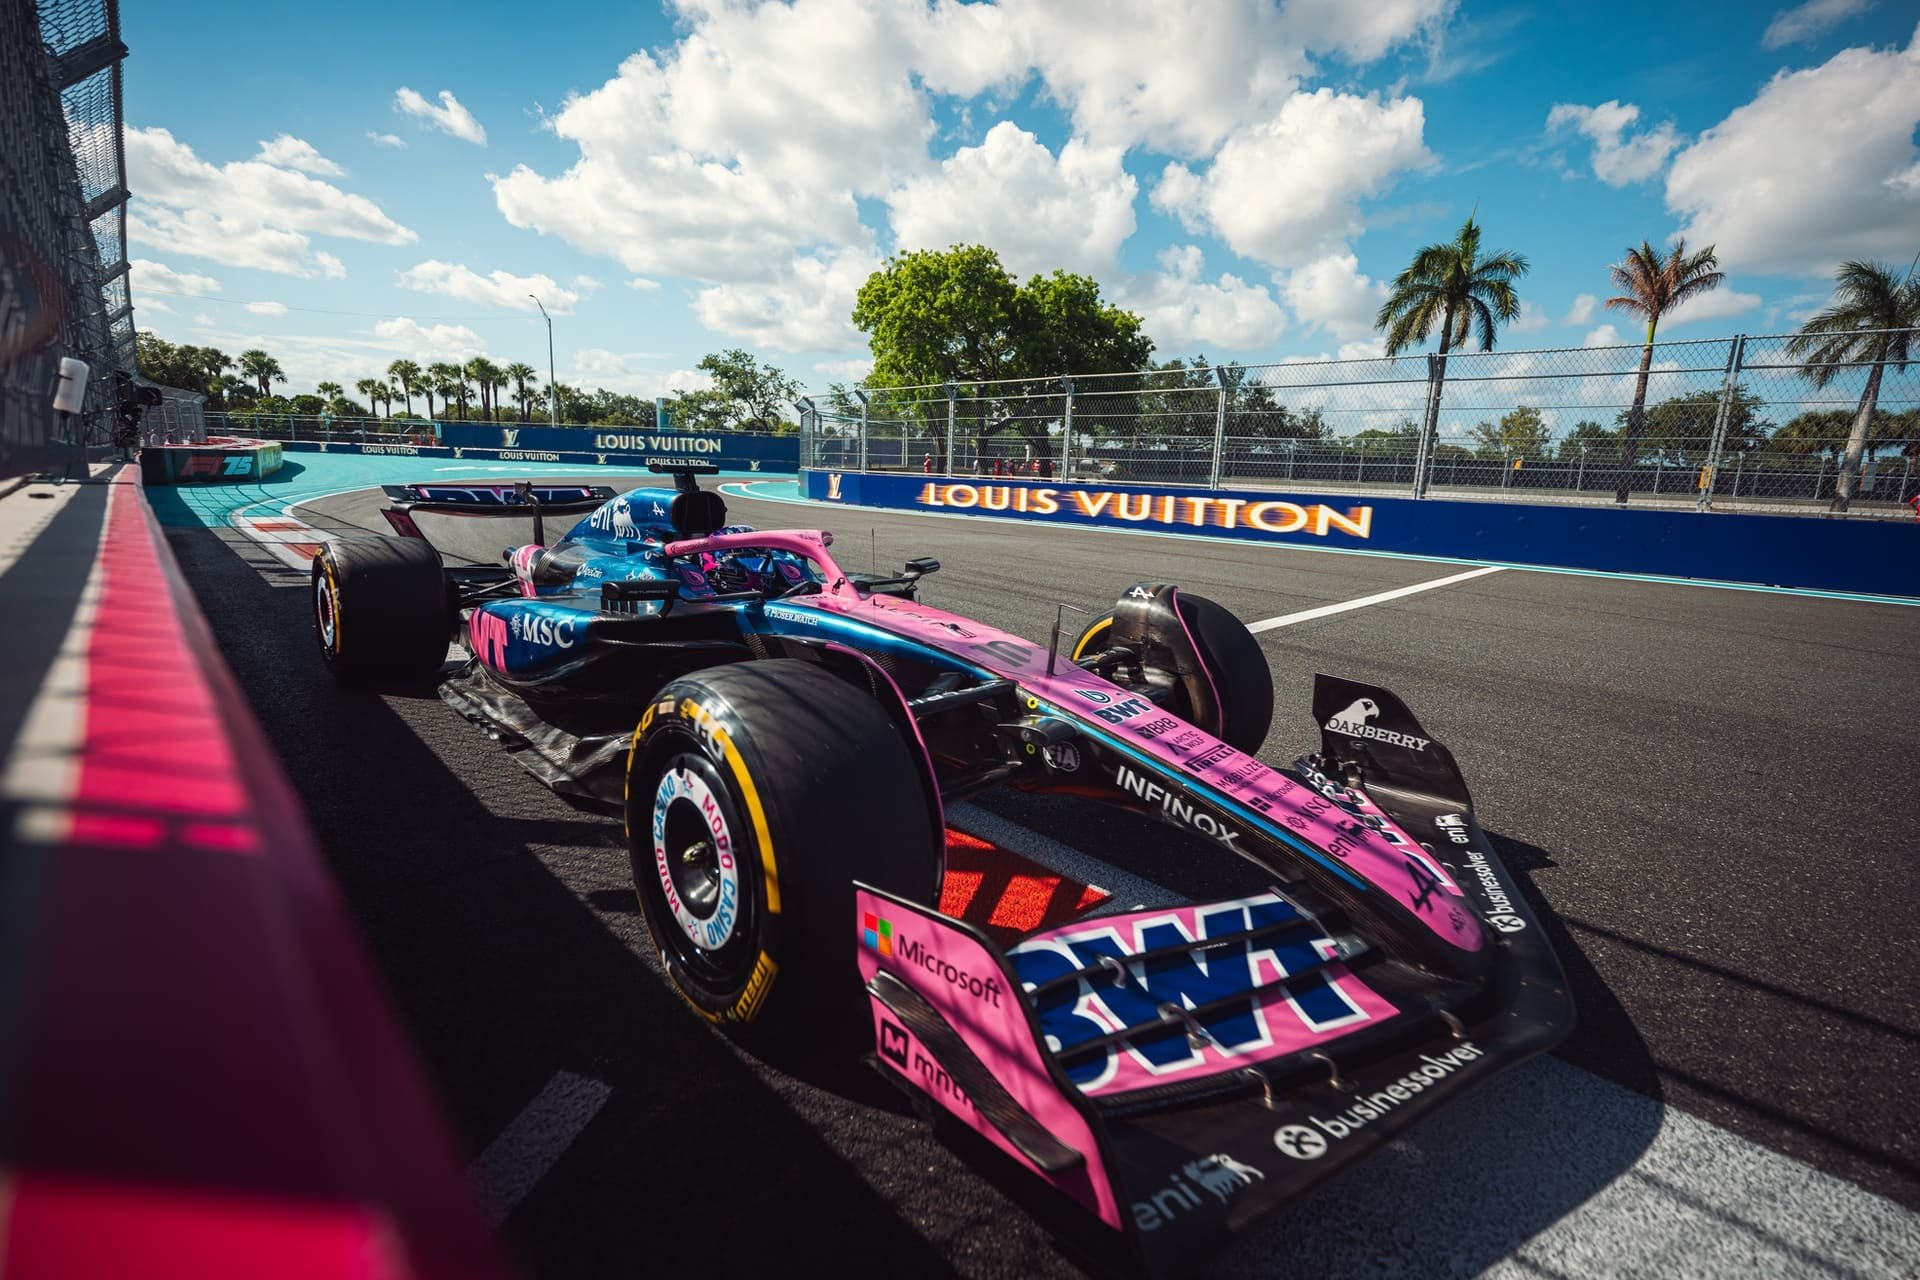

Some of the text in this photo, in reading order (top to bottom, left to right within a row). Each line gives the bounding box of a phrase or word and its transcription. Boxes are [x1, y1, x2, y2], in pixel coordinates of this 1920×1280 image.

[362, 445, 419, 456] LOUIS VUITTON
[499, 451, 560, 462] LOUIS VUITTON
[595, 434, 722, 453] LOUIS VUITTON
[646, 457, 671, 465] LOUIS
[223, 456, 254, 476] 75
[590, 506, 611, 531] eni
[925, 482, 1373, 540] LOUIS VUITTON
[523, 613, 575, 649] MSC
[1091, 697, 1152, 725] BWT
[1146, 717, 1179, 736] BRB
[1325, 717, 1431, 752] OAKBERRY
[1183, 743, 1237, 773] PIRELLI
[653, 775, 675, 841] CASINO
[1116, 765, 1240, 850] INFINOX
[1295, 796, 1332, 823] MSC
[702, 793, 733, 870] MODO
[1328, 820, 1360, 859] eni
[1440, 824, 1470, 844] eni
[656, 848, 680, 914] MODO
[1463, 850, 1516, 915] businessolver
[707, 878, 736, 946] CASINO
[735, 950, 778, 1022] PIRELLI
[898, 933, 1002, 1009] Microsoft
[1308, 1040, 1485, 1140] businessolver
[1130, 1172, 1201, 1232] eni
